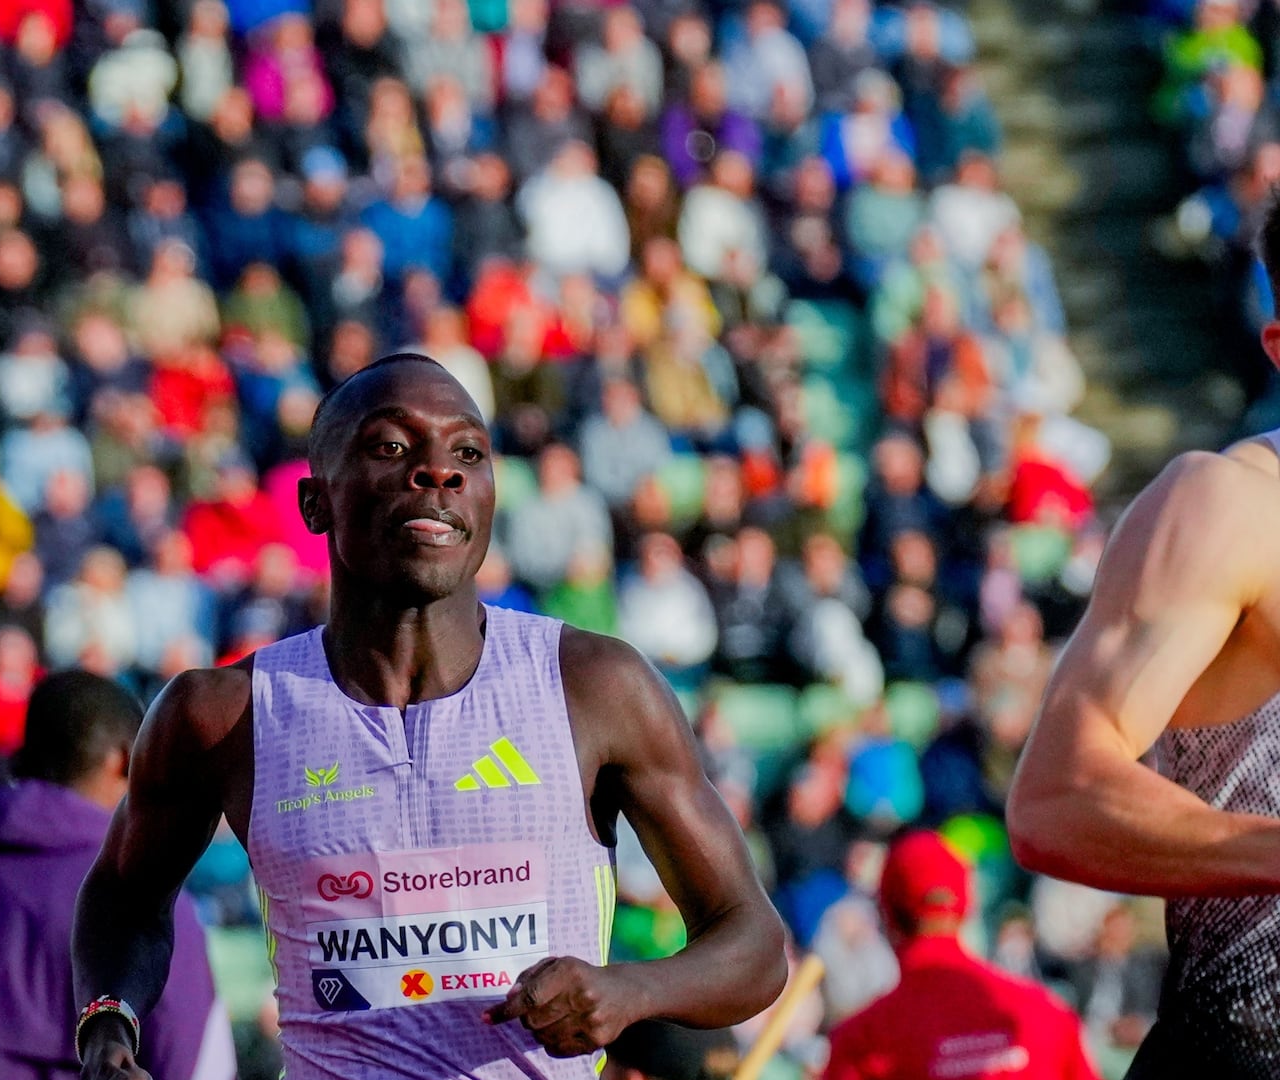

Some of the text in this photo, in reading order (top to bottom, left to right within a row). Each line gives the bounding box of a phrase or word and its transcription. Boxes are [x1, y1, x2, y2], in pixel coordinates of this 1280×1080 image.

[276, 785, 375, 814] Tirop's Angels
[383, 860, 531, 893] Storebrand
[317, 913, 537, 962] WANYONYI
[441, 972, 512, 990] EXTRA
